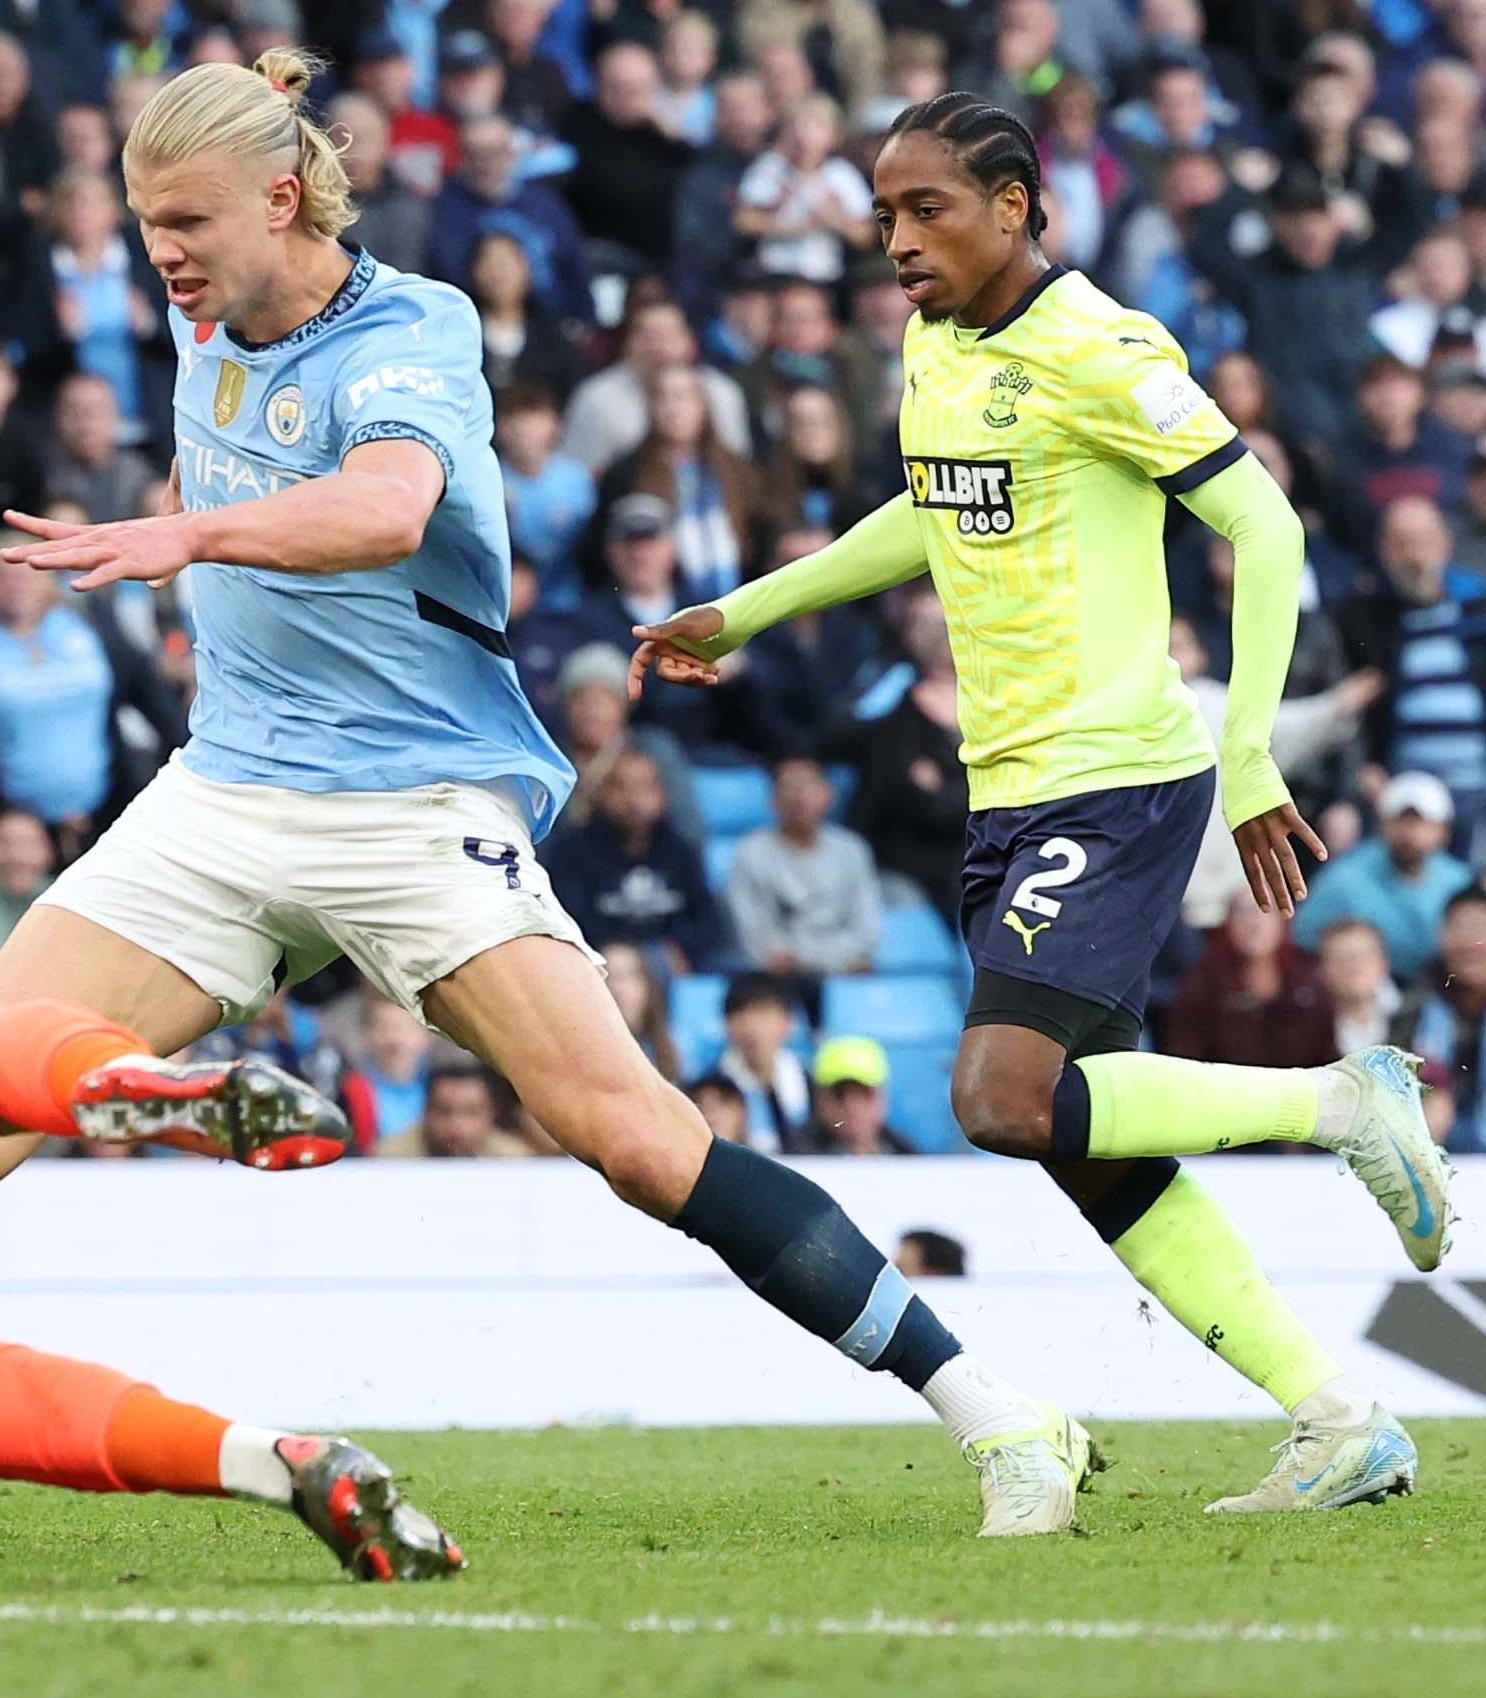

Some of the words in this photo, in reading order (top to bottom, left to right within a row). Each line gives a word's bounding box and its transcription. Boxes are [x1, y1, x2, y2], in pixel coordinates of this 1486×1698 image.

[904, 461, 1006, 506] OLLBIT
[462, 836, 521, 890] 9
[1010, 836, 1088, 919] 2
